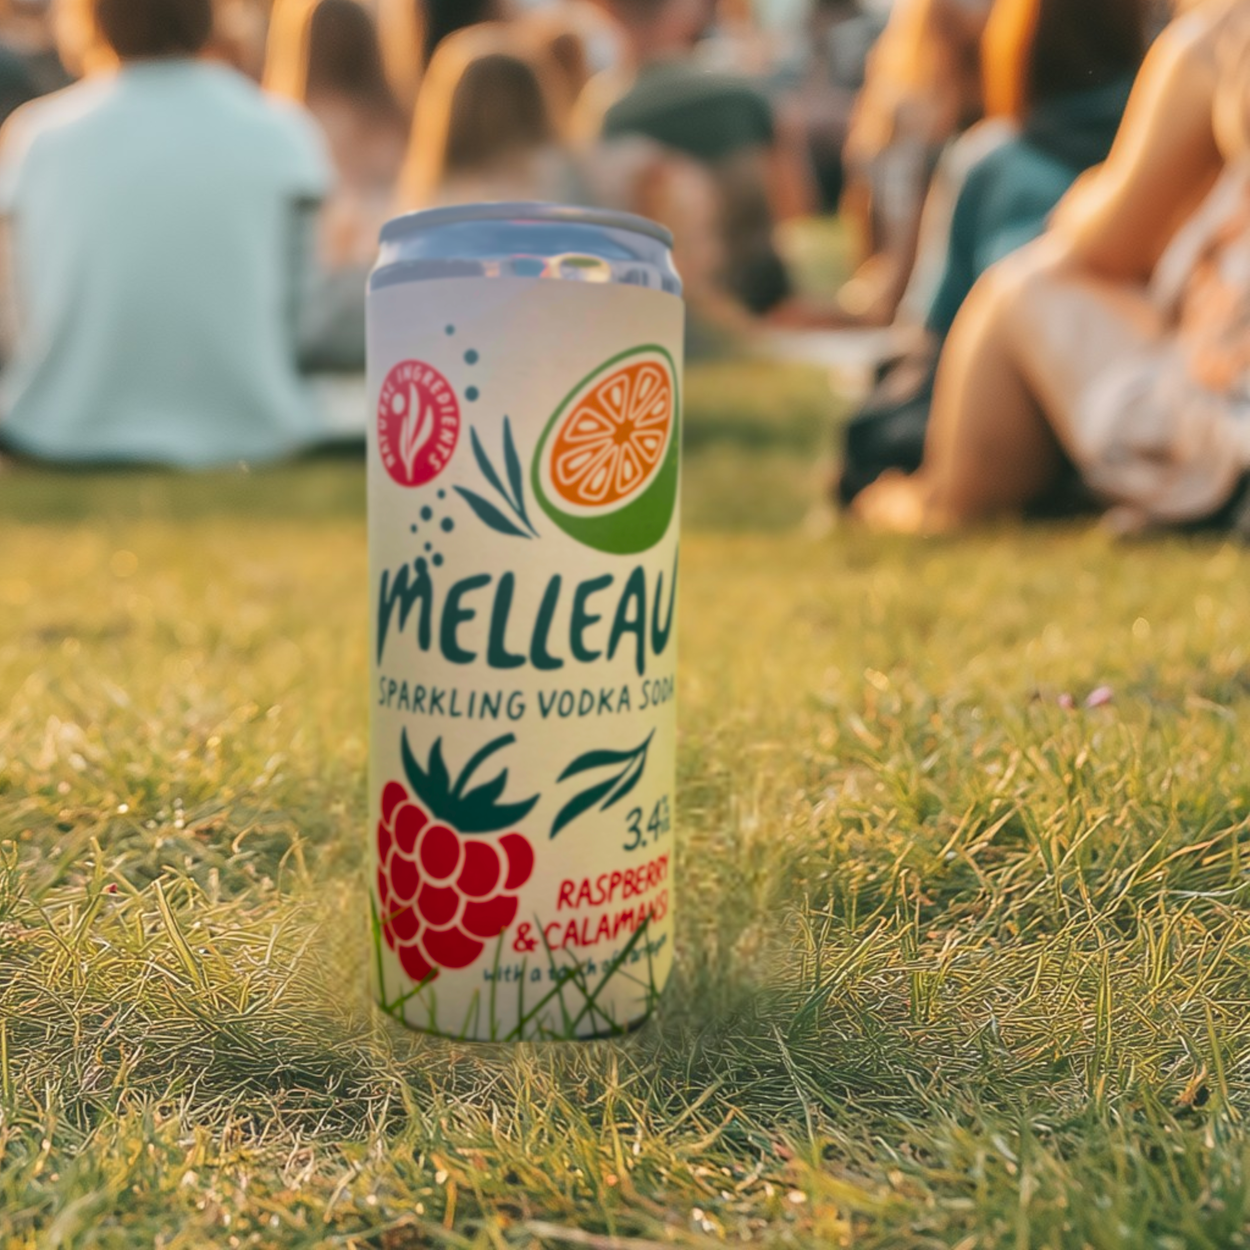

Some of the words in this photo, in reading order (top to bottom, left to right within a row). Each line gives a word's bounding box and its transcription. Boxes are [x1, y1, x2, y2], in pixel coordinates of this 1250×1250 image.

[396, 364, 458, 471] INGREDIENTS
[376, 540, 679, 677] MELLEAU
[378, 675, 526, 721] SPARKLING
[537, 684, 631, 719] VODKA
[513, 922, 539, 953] &
[530, 967, 541, 982] a
